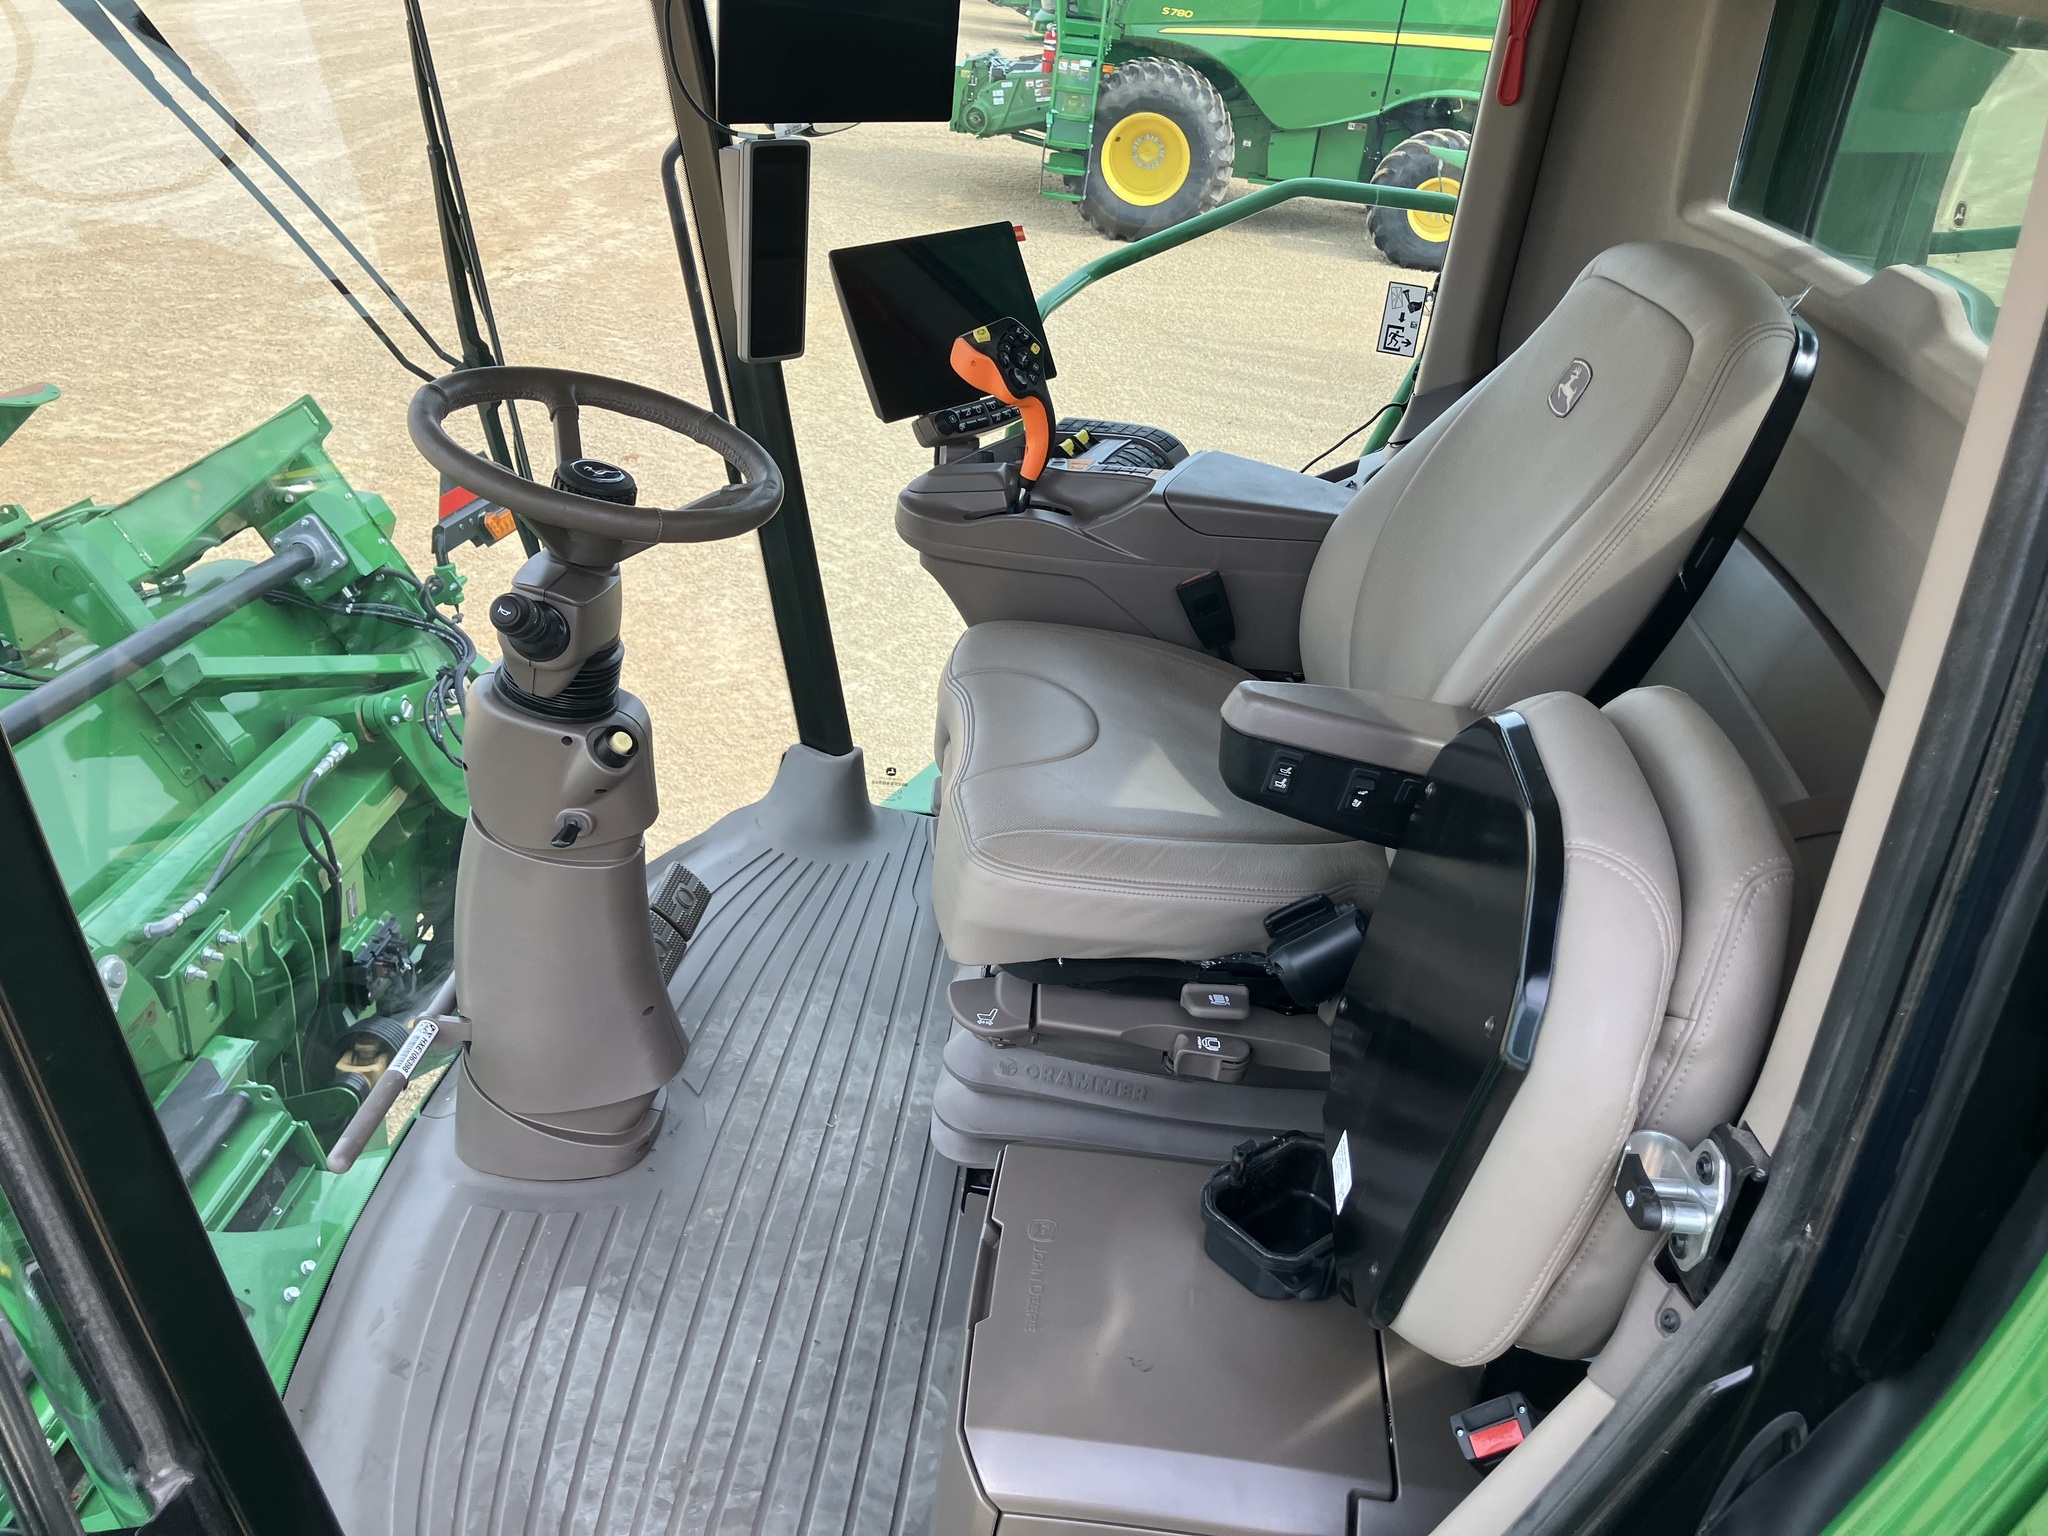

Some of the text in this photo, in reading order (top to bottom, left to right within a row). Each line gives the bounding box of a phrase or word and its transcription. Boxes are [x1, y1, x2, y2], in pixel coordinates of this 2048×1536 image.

[1161, 6, 1195, 19] S780
[401, 1036, 429, 1074] HXE106398
[1022, 1062, 1150, 1102] GRAMMER
[1029, 1244, 1048, 1282] JOHN
